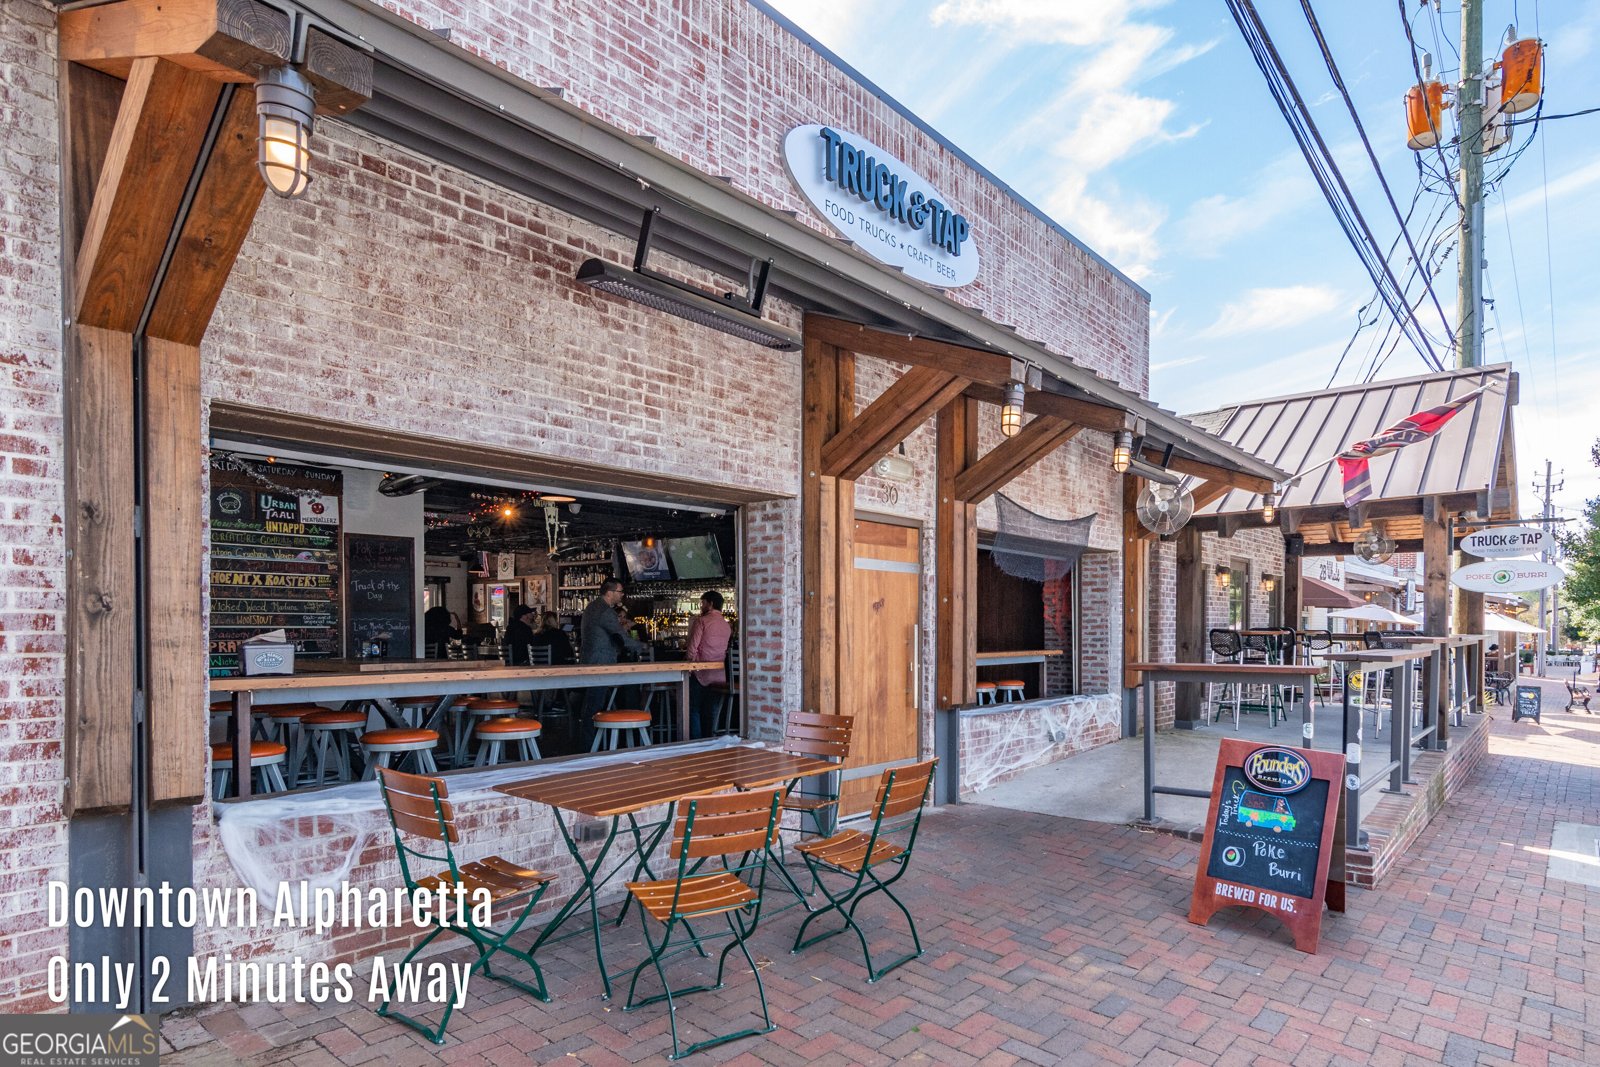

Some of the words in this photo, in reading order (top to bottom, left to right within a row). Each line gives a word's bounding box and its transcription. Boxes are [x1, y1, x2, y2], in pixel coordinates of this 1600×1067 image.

[820, 127, 908, 224] TRUCK
[928, 198, 969, 256] TAP
[824, 199, 855, 225] FOOD
[859, 216, 897, 248] TRUCKS
[907, 244, 934, 269] CRAFT
[936, 261, 956, 281] BEER
[257, 464, 298, 477] SATURDAY
[305, 471, 336, 481] SUNDAY
[260, 495, 297, 510] URBAN
[262, 508, 295, 520] TAALI
[265, 521, 305, 534] UNTAPPD
[1470, 535, 1508, 547] TRUCK
[1508, 535, 1519, 545] &
[1520, 532, 1543, 545] TAP
[210, 572, 263, 585] HOENIX
[265, 574, 317, 587] ROASTERS
[1517, 571, 1548, 579] BURRI
[351, 580, 376, 592] Truck
[377, 580, 385, 590] of
[386, 580, 400, 592] the
[368, 592, 383, 601] Day
[1251, 753, 1305, 785] Founders
[1219, 799, 1233, 827] Today's
[1230, 793, 1240, 816] Truck
[1252, 841, 1285, 860] Poke
[1269, 862, 1302, 882] Burri
[1215, 882, 1255, 903] BREWED
[1258, 892, 1278, 908] FOR
